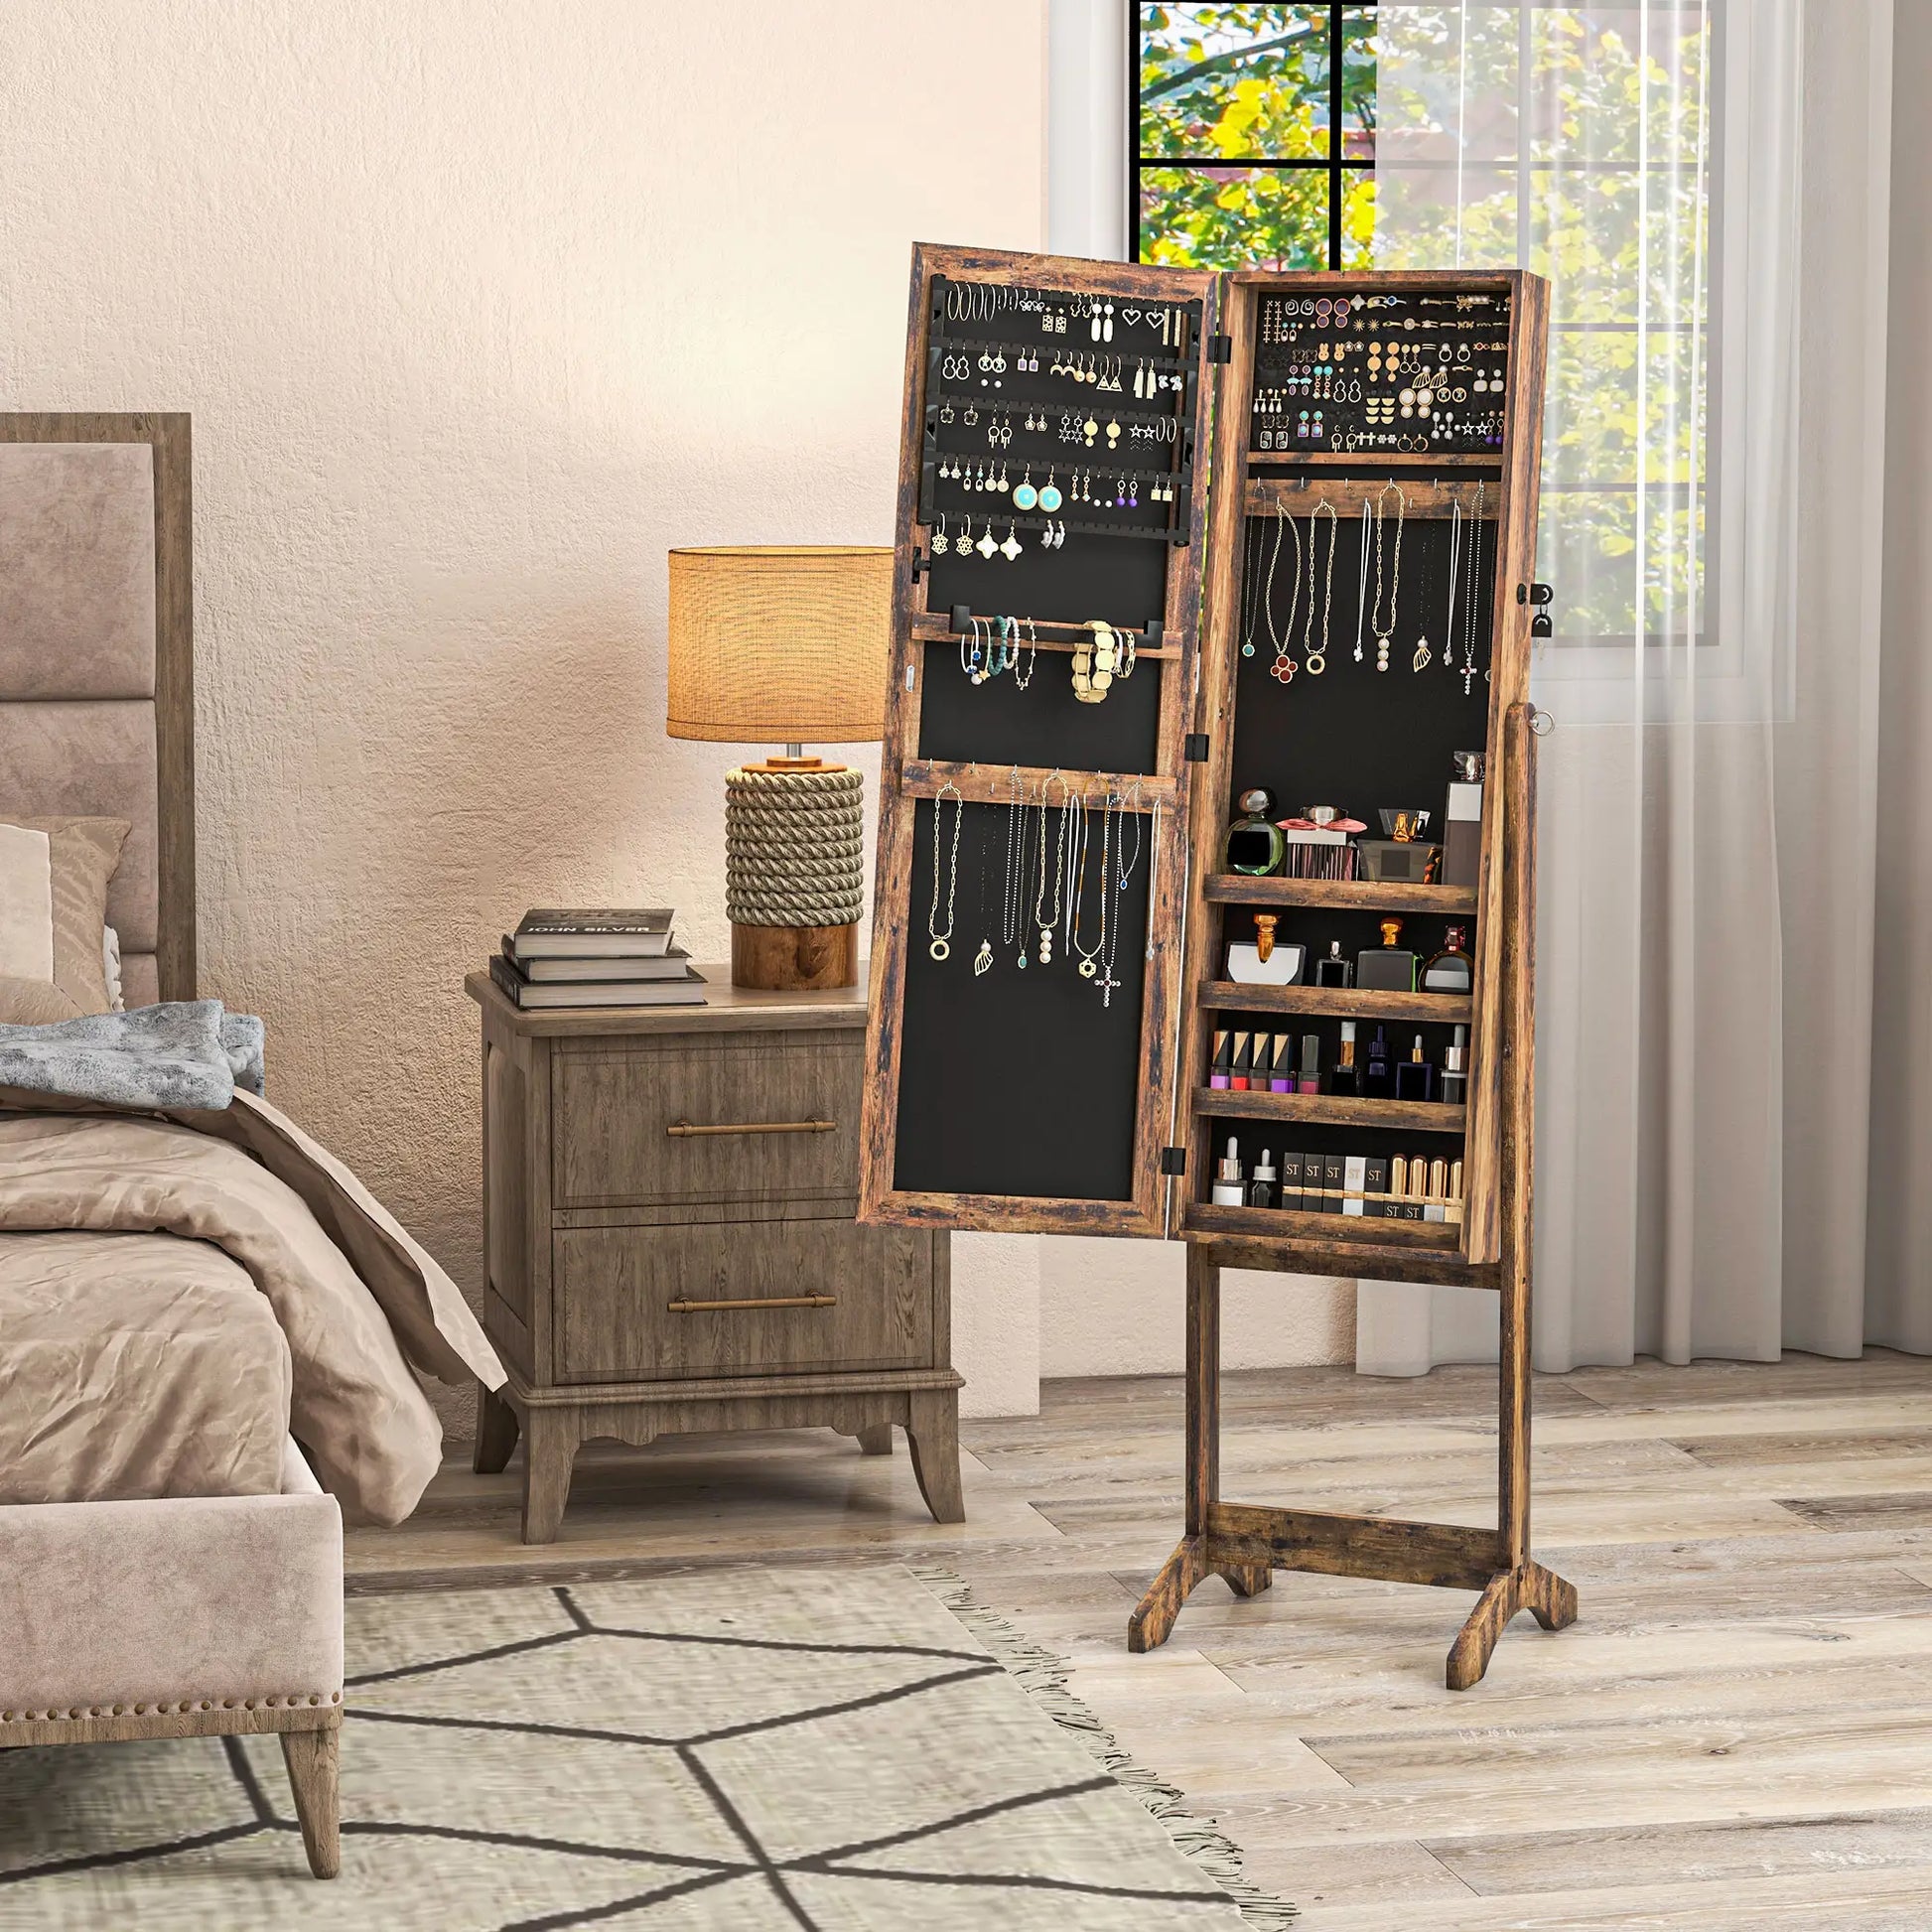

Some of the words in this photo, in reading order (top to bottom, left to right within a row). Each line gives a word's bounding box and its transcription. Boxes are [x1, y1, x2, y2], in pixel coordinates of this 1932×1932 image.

[1286, 1164, 1299, 1175] ST
[1307, 1166, 1319, 1177] ST
[1327, 1167, 1340, 1178] ST
[1348, 1169, 1361, 1179] ST
[1368, 1170, 1381, 1181] ST
[1386, 1206, 1399, 1217] ST
[1407, 1207, 1420, 1218] ST
